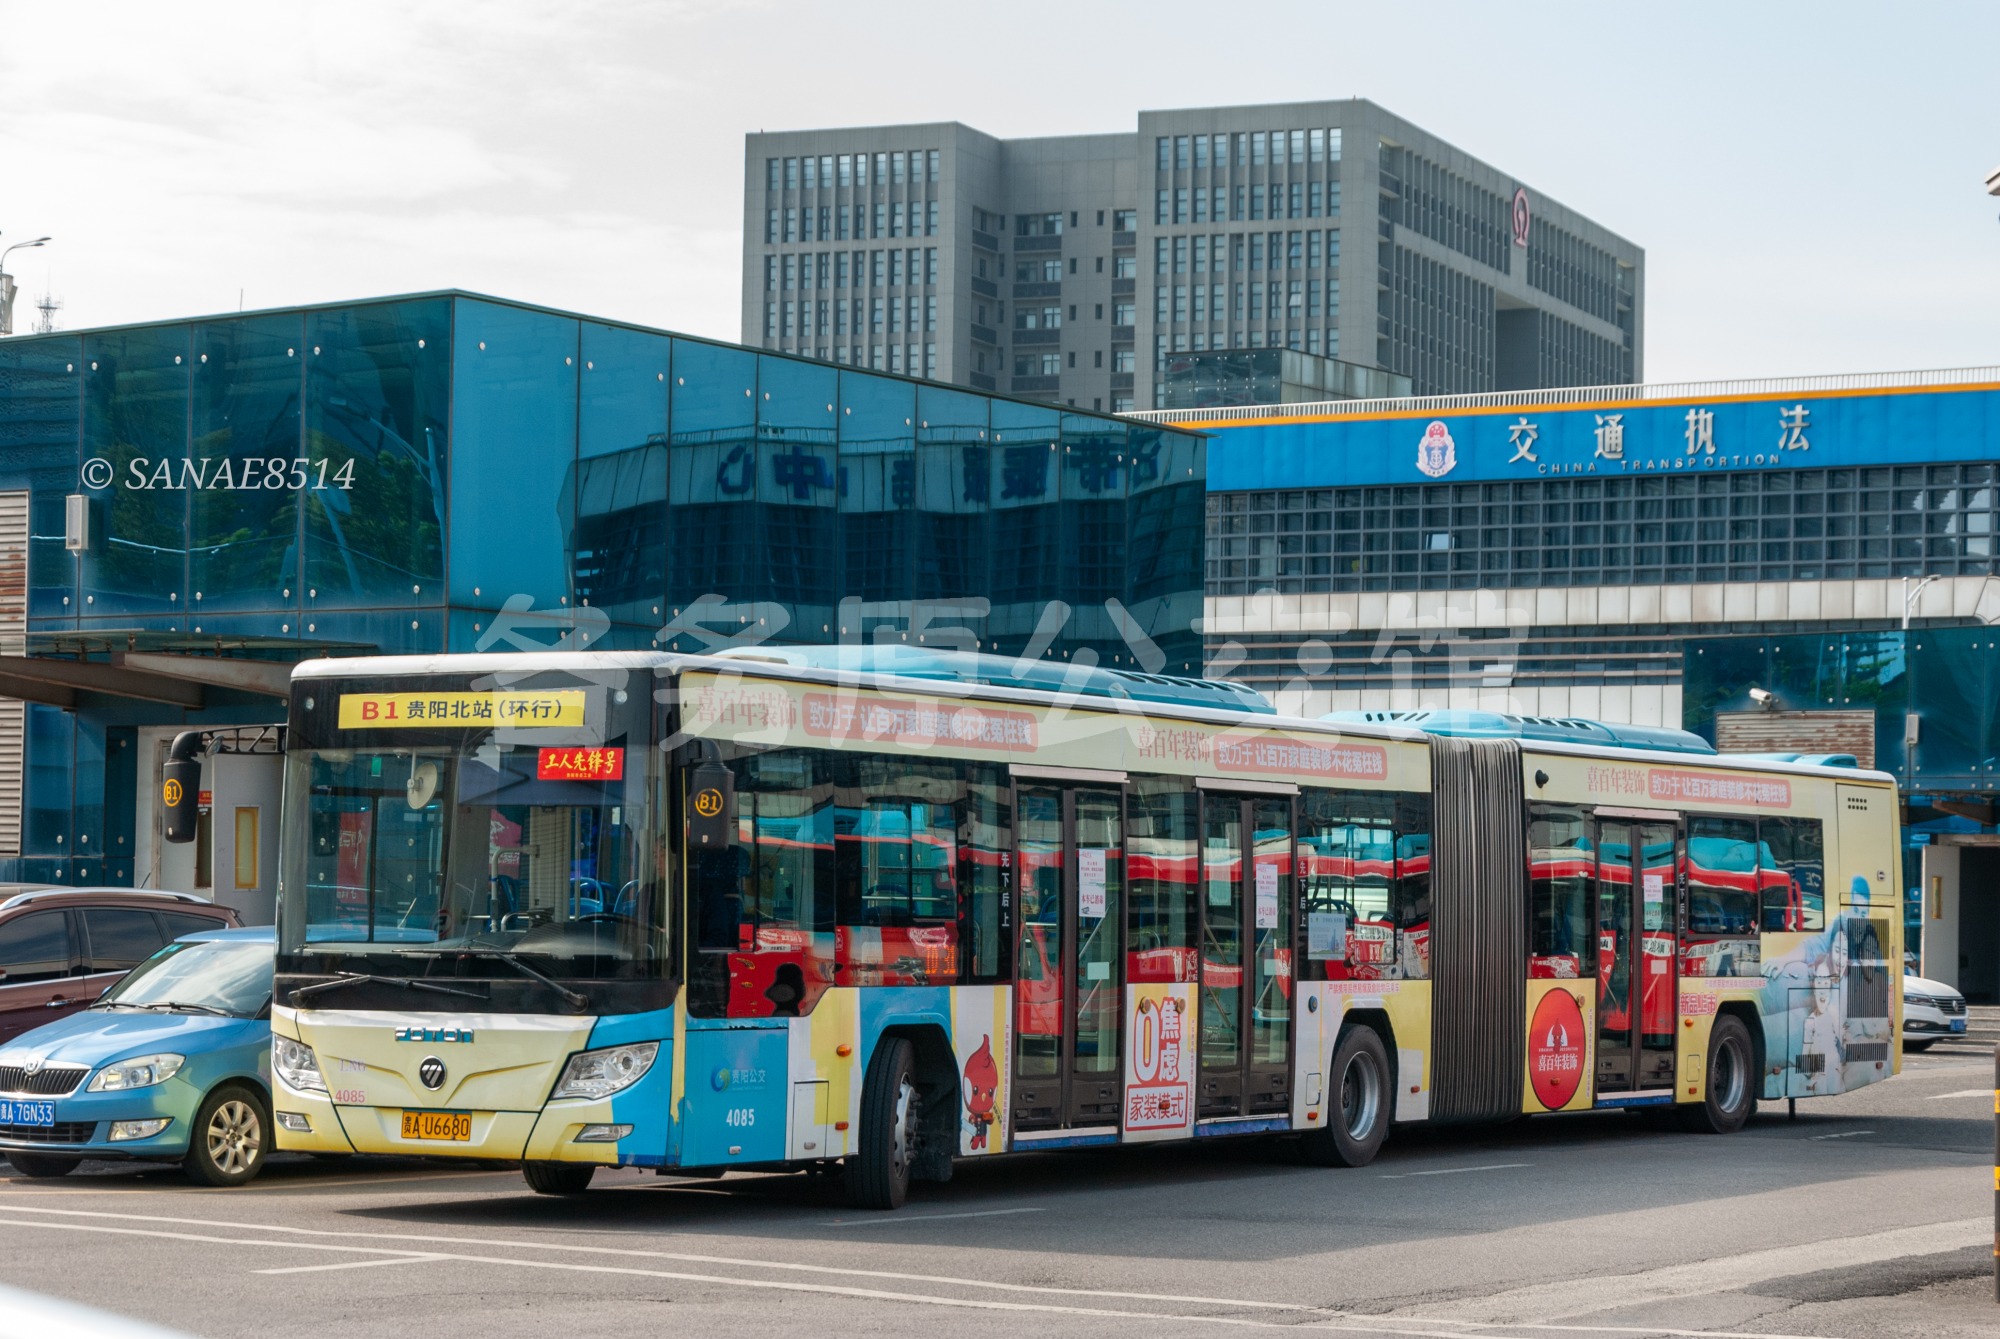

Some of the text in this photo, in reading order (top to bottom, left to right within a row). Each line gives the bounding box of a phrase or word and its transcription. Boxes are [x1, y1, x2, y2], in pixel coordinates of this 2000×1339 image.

[1508, 404, 1811, 464] 交通执法
[1538, 453, 1780, 474] CHINA TRANSPORTION
[361, 701, 399, 720] B1
[810, 702, 1032, 746] 致力于 让百万家庭装修不花冤枉钱
[1137, 726, 1210, 762] 喜百年装饰
[545, 750, 615, 774] 工人先锋号
[1219, 741, 1383, 775] 致力于 让百万家庭装修不花冤枉钱
[1586, 766, 1645, 795] 喜百年装饰
[1652, 773, 1680, 794] 致力于
[165, 785, 178, 800] B1
[700, 793, 717, 810] B1
[1002, 852, 1010, 927] 先下后上
[1680, 993, 1716, 1014] 新品上市
[732, 1069, 766, 1083] 贵阳公交
[335, 1089, 366, 1103] 4085
[1129, 1092, 1184, 1121] 家装模式
[726, 1108, 755, 1127] 4085
